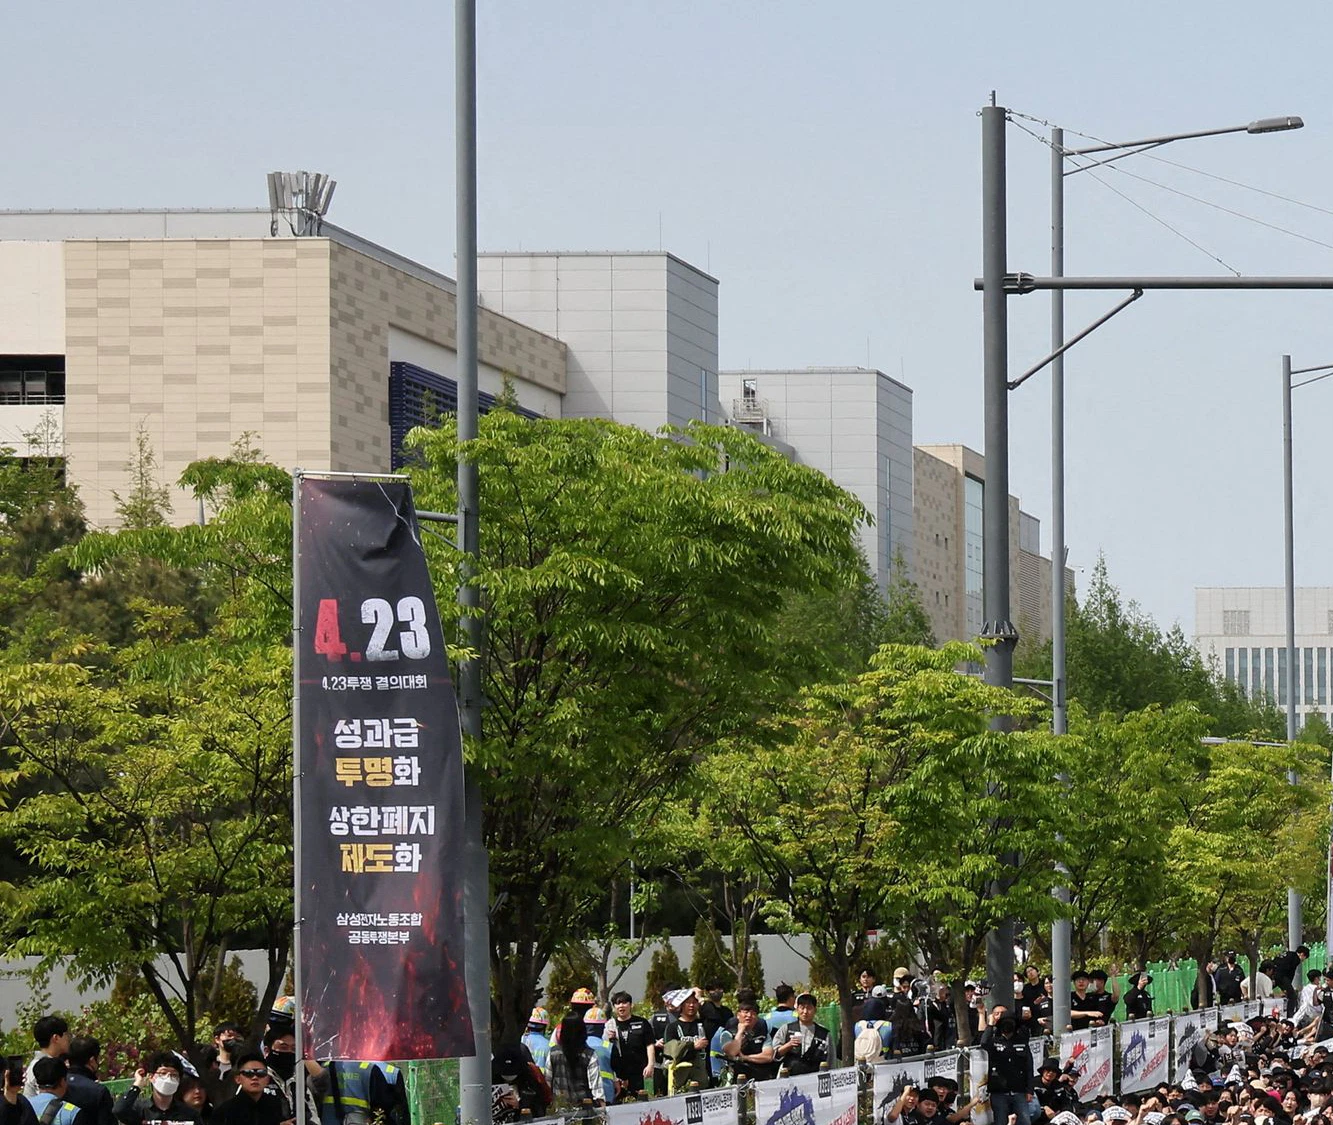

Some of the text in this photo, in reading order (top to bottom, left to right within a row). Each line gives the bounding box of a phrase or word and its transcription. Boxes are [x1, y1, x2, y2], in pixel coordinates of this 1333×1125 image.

[315, 596, 431, 662] 4.23
[322, 674, 428, 690] 4.23투쟁 결의대회
[334, 718, 420, 749] 성과급
[335, 756, 422, 787] 투명화
[329, 805, 436, 837] 상한폐지
[340, 843, 422, 874] 제도화
[336, 912, 423, 927] 삼성전자노동조합
[348, 930, 410, 944] 공동투쟁본부
